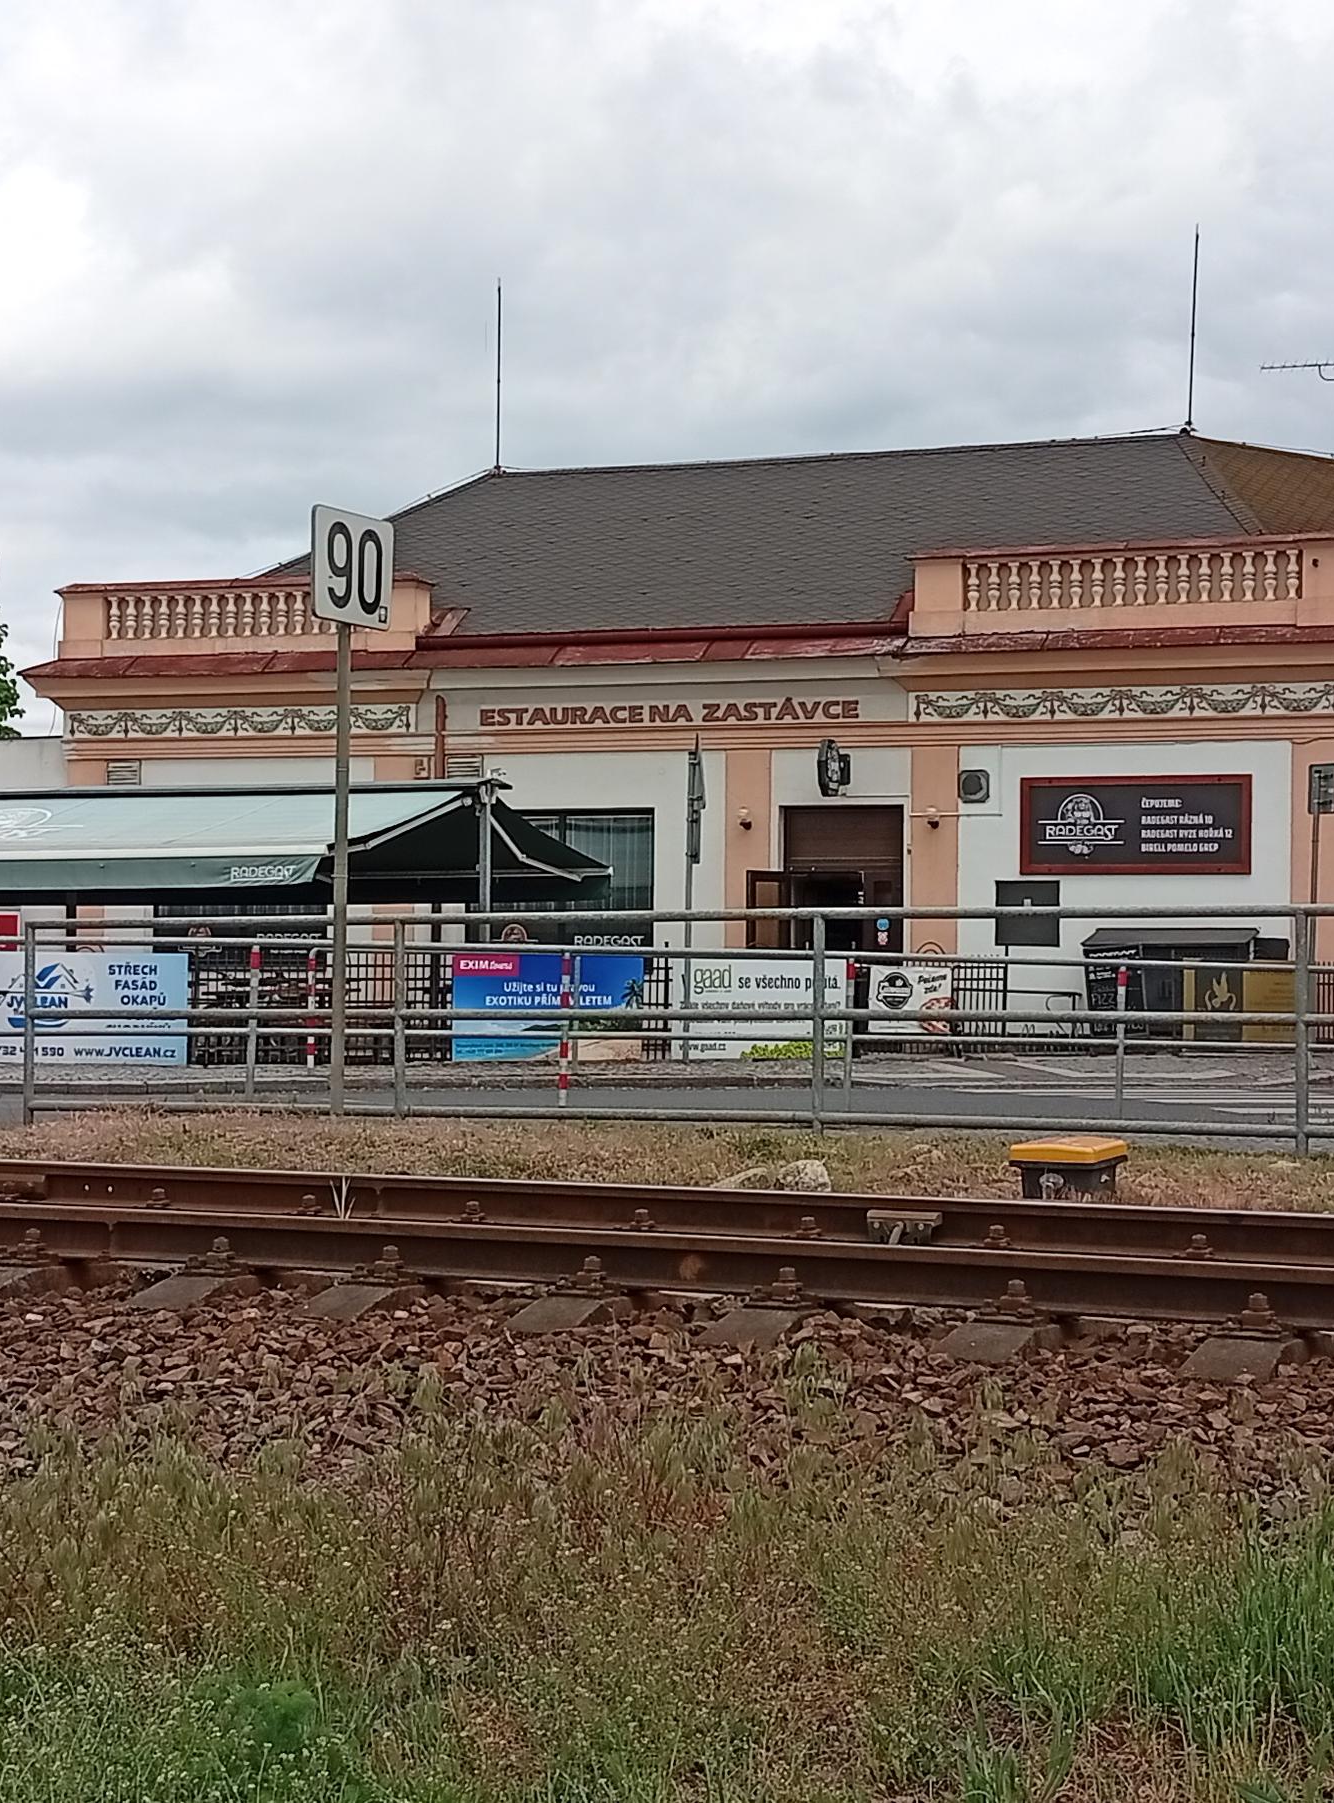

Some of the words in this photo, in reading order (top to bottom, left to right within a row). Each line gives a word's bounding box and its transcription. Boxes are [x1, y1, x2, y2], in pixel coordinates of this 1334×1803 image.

[327, 521, 383, 615] 90
[479, 704, 644, 726] ESTAURACE
[650, 704, 693, 723] NA
[701, 697, 860, 722] ZASTÁVCE
[1141, 815, 1178, 825] RADEGAST
[1046, 825, 1119, 841] RADEGAST
[1141, 829, 1178, 838] RADEGAST
[1225, 828, 1233, 838] 12
[230, 865, 297, 881] RADEGAST
[108, 961, 158, 976] STŘECH
[460, 960, 488, 970] EXIM
[115, 976, 158, 991] FASÁD
[694, 964, 732, 994] gaad
[738, 976, 751, 990] se
[755, 974, 801, 989] všechno
[503, 981, 534, 995] Užijte
[535, 982, 544, 992] si
[546, 983, 557, 992] tu
[7, 996, 68, 1009] JVLEAN
[120, 992, 166, 1006] OKAPŮ
[485, 996, 533, 1006] EXOTIKU
[580, 996, 612, 1006] LETEM
[42, 1047, 65, 1057] 590
[74, 1046, 176, 1059] www.JVCLEAN.cz
